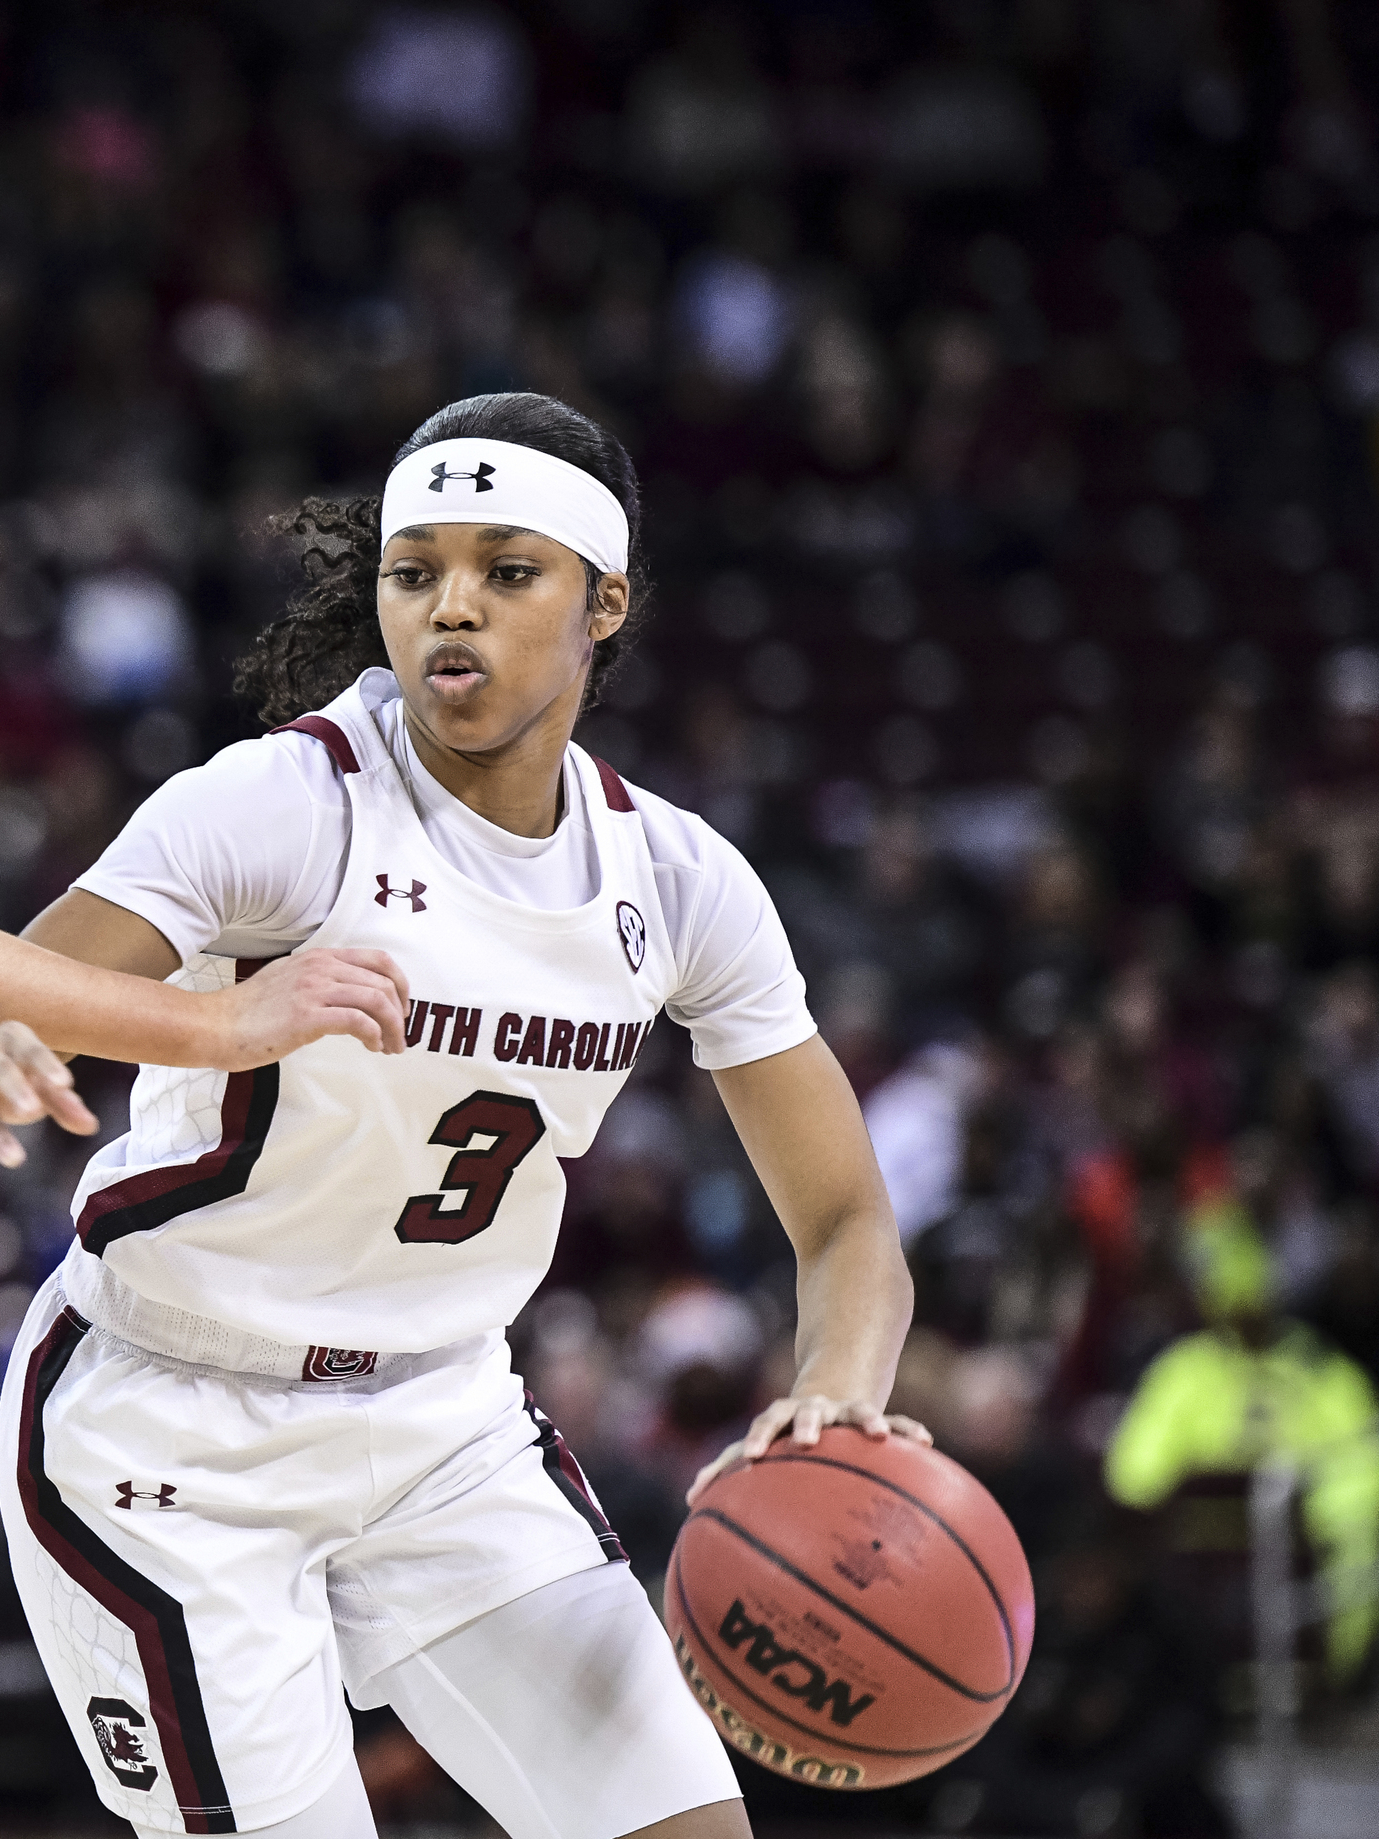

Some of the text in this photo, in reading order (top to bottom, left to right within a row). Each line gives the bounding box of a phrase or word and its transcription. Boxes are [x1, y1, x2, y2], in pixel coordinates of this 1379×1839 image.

[404, 998, 483, 1057] UTH
[394, 1089, 547, 1245] 3
[718, 1597, 877, 1727] NCAA
